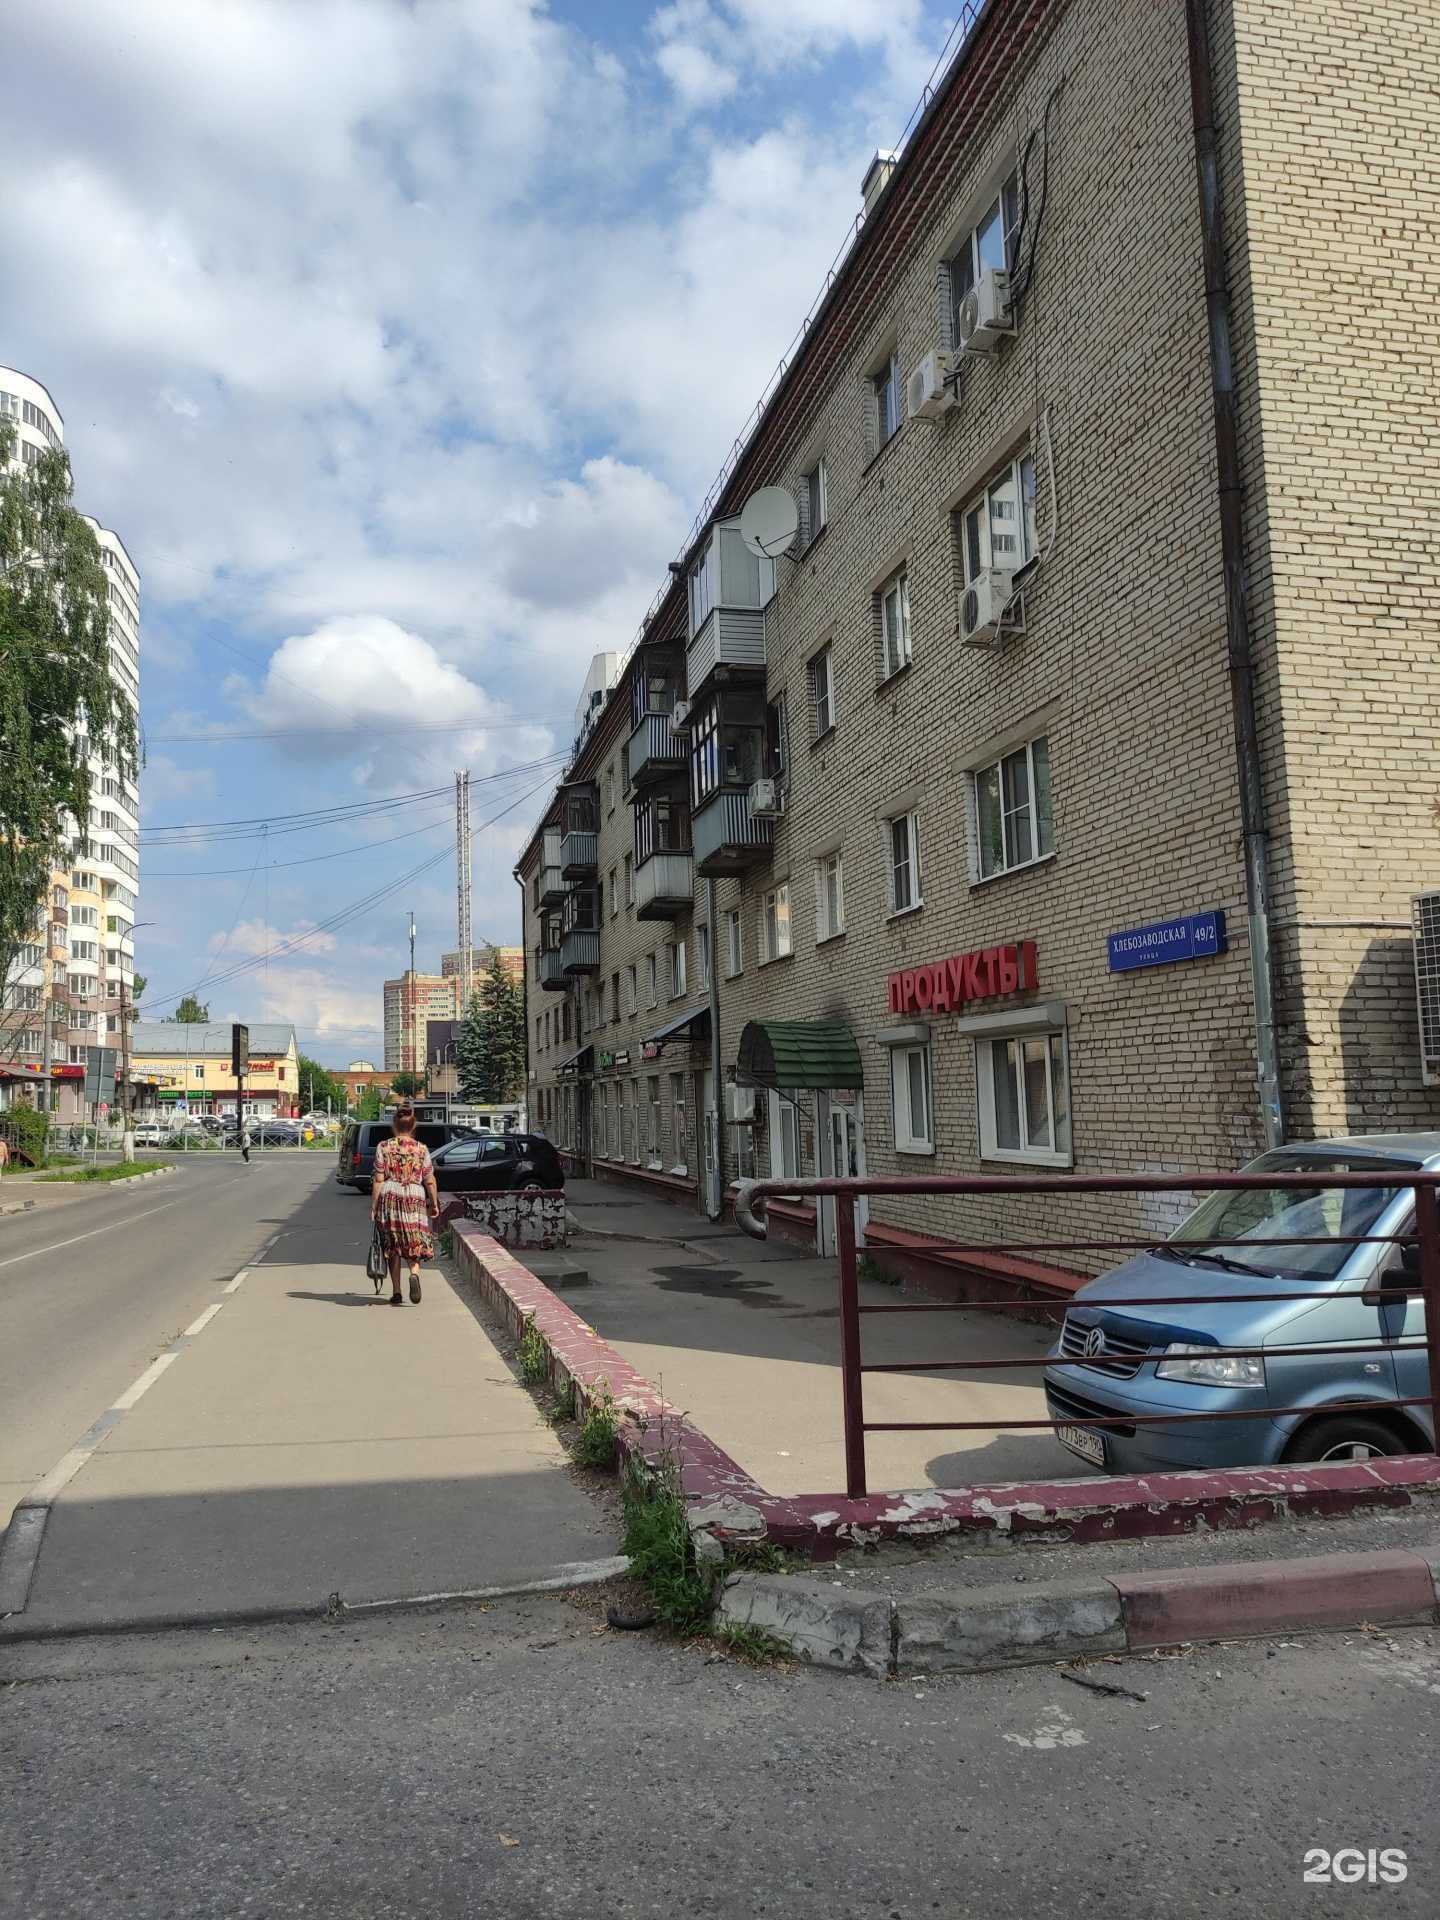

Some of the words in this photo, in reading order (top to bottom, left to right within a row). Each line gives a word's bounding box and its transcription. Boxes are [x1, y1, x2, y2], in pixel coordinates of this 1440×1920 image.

[1113, 926, 1185, 953] ХЛЕБОЗАВОДСКАЯ
[1194, 926, 1215, 942] 49/2
[888, 940, 1036, 1013] ПРОДУКТЫ
